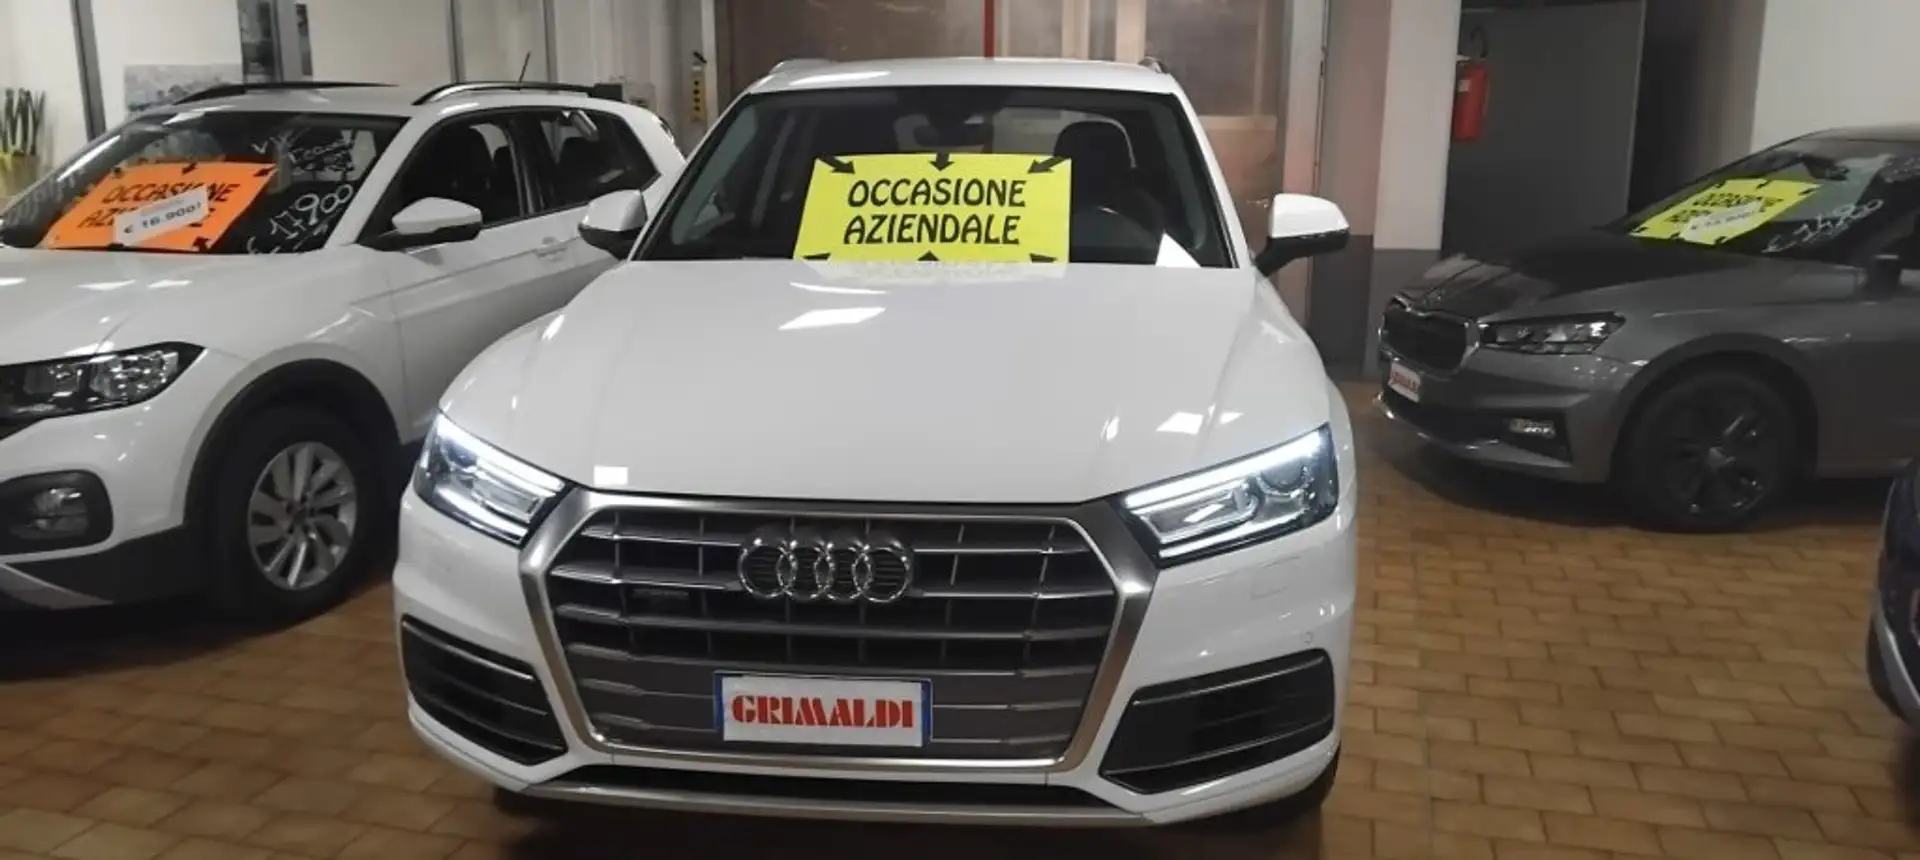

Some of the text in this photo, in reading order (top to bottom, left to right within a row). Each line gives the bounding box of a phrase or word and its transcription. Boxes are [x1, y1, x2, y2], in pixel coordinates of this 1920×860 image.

[102, 182, 241, 203] OCCASNE
[847, 177, 1027, 208] OCCASIONE
[843, 213, 1021, 245] AZIENDALE
[732, 695, 914, 729] GRIMALDI
